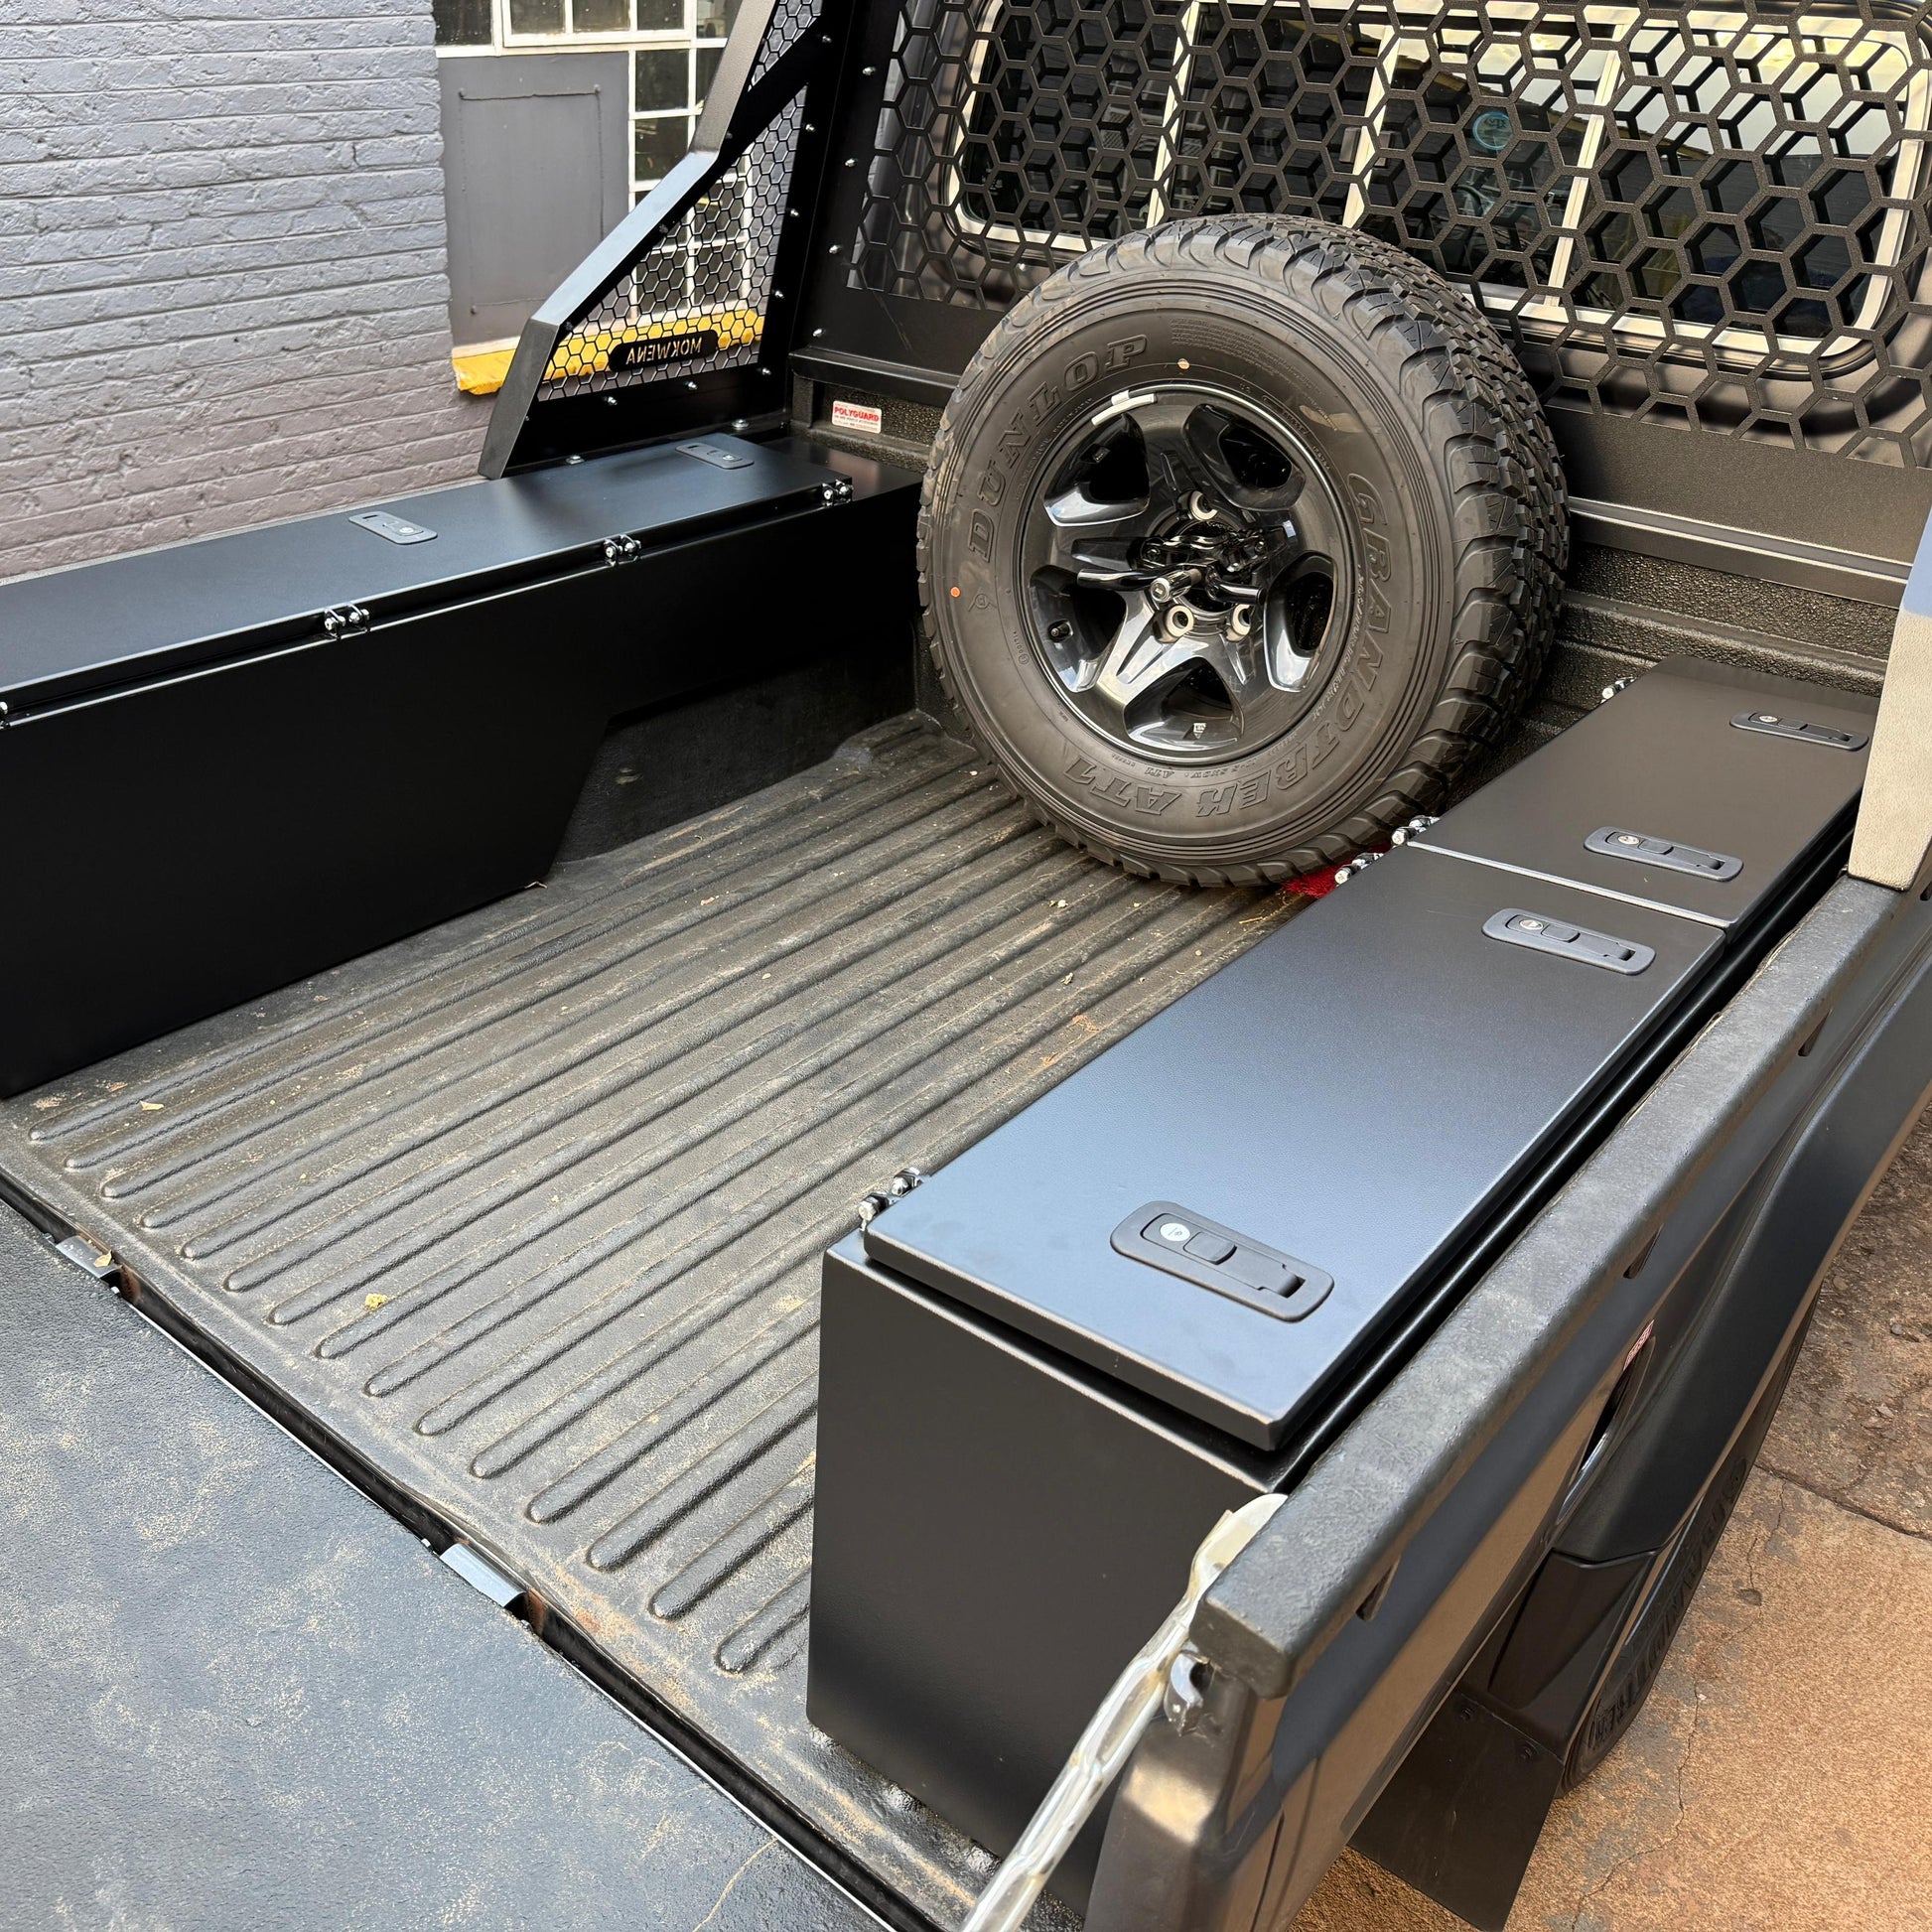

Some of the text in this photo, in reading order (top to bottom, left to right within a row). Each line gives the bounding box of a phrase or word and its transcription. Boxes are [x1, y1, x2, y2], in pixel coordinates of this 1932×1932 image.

[834, 406, 880, 422] POLYGUARD
[969, 334, 1148, 562] DUNLOP
[1195, 474, 1391, 817] GRANDTREK
[1063, 755, 1181, 815] AT1
